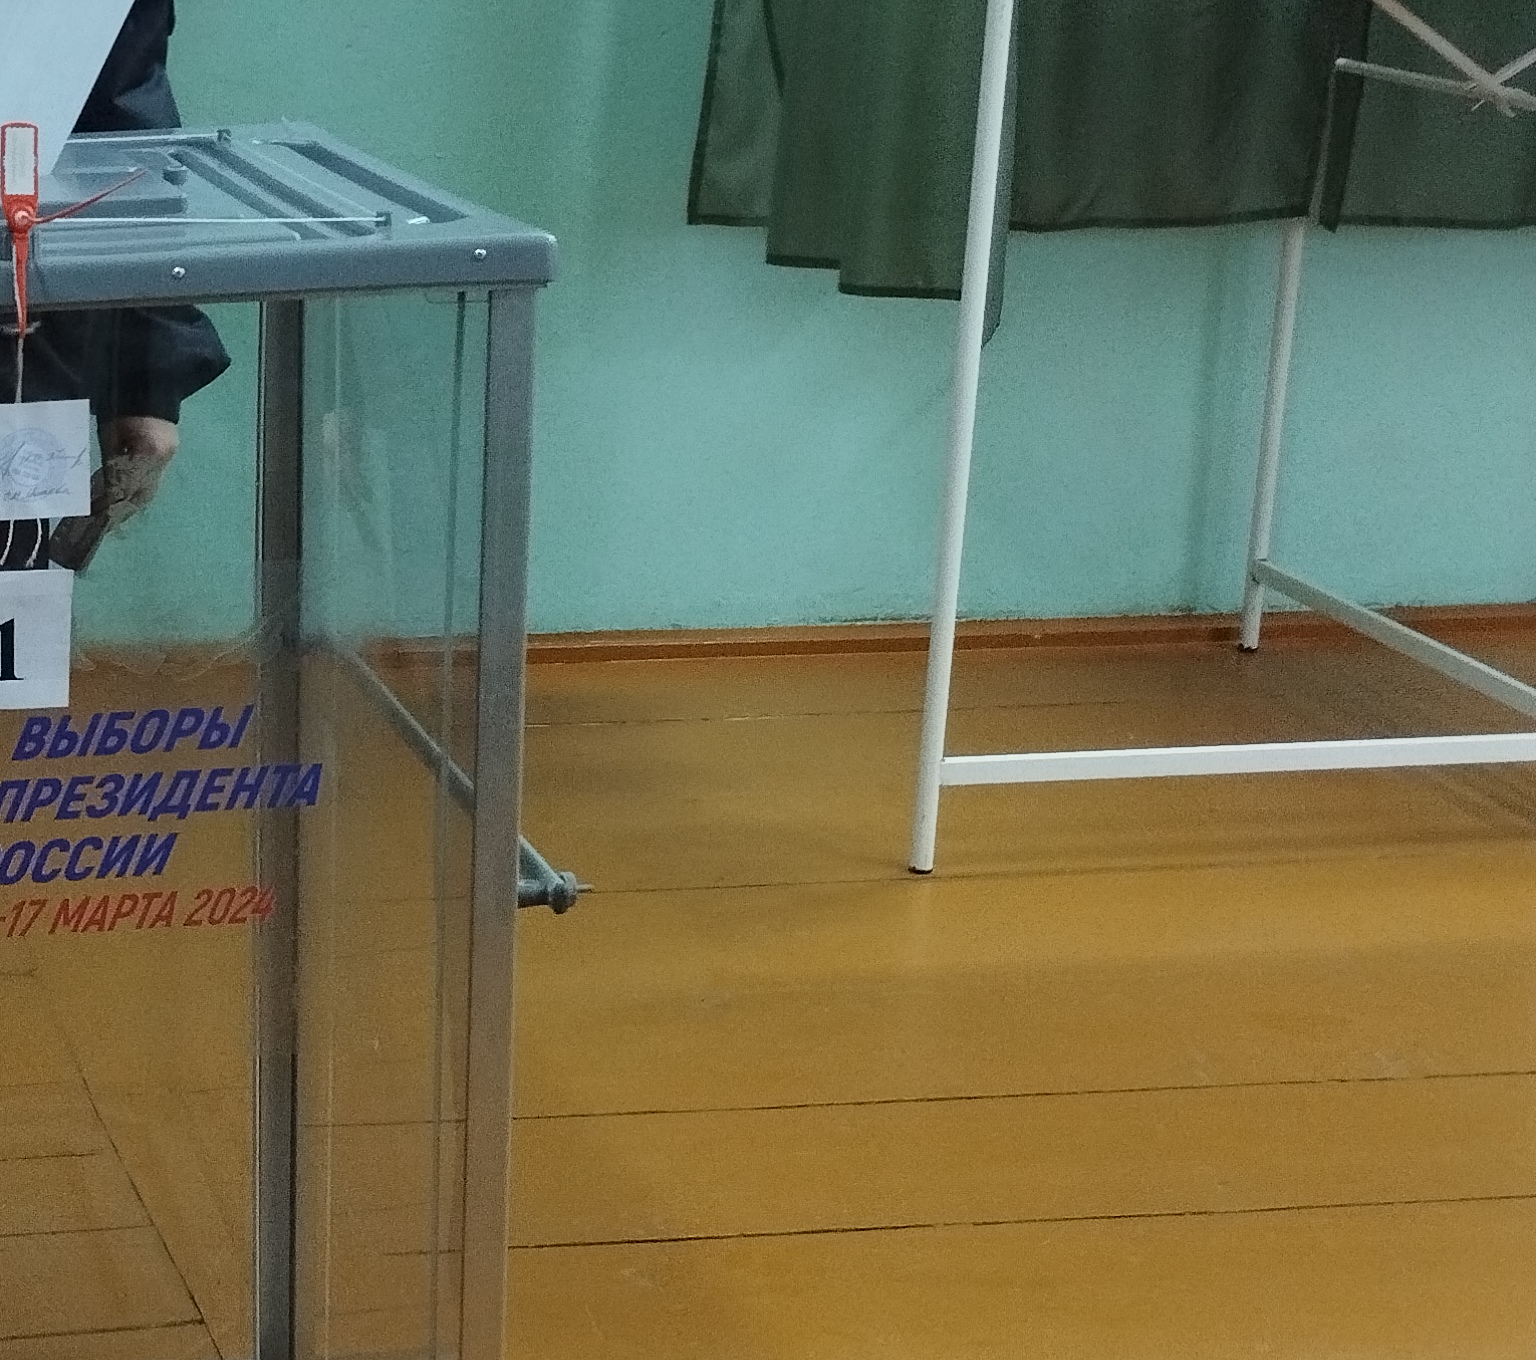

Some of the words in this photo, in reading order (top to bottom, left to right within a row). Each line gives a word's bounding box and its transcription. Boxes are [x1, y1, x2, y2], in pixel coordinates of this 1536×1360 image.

[11, 704, 254, 761] ВЫБОРЫ
[48, 891, 179, 935] МАРТА
[183, 886, 276, 927] 2024
